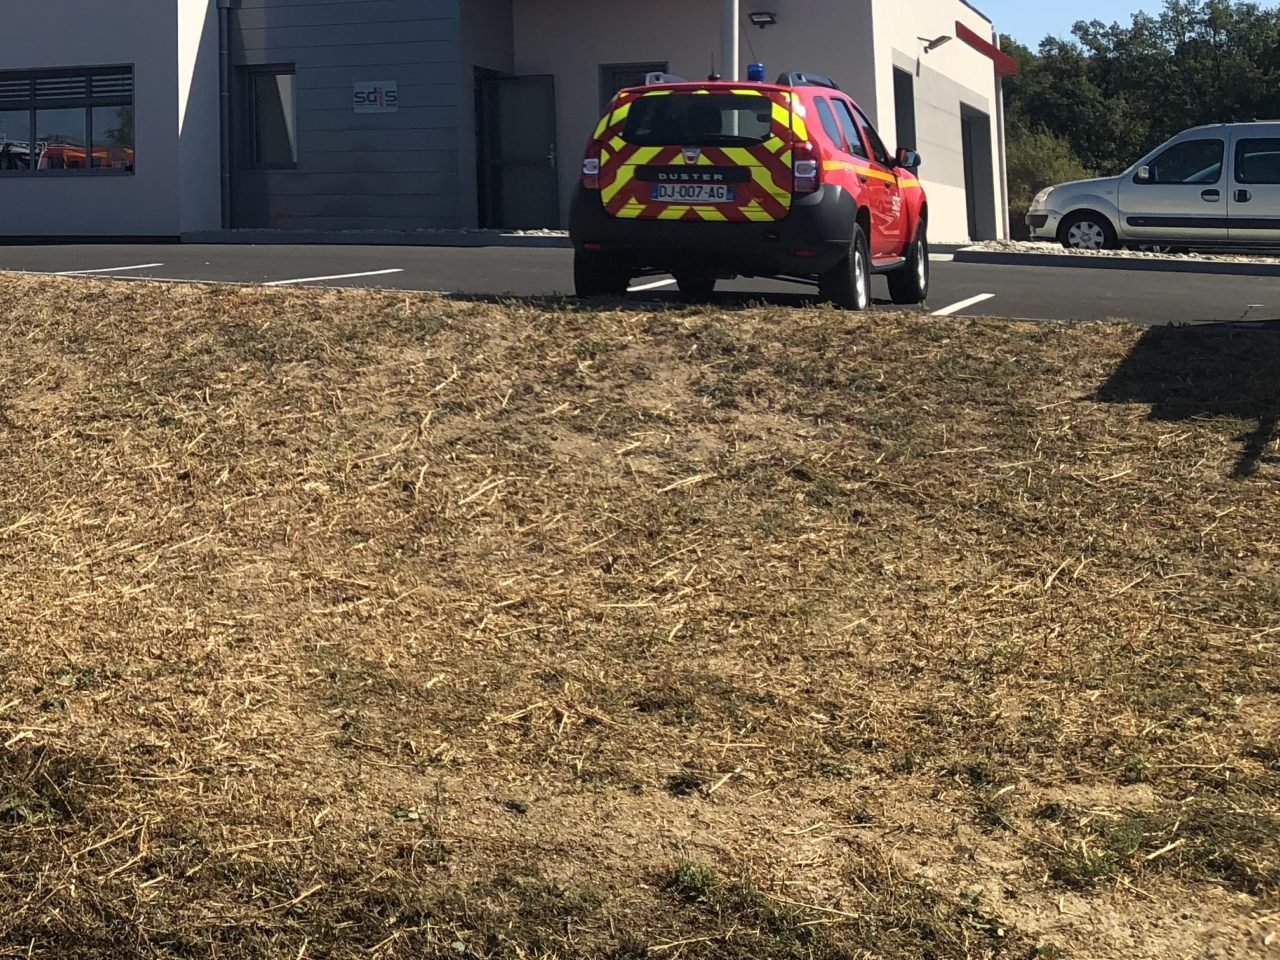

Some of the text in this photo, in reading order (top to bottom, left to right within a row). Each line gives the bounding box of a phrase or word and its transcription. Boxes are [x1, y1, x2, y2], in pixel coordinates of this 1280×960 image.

[354, 86, 398, 106] sdis
[658, 173, 723, 181] DUSTER
[659, 185, 725, 198] DJ-007-AG
